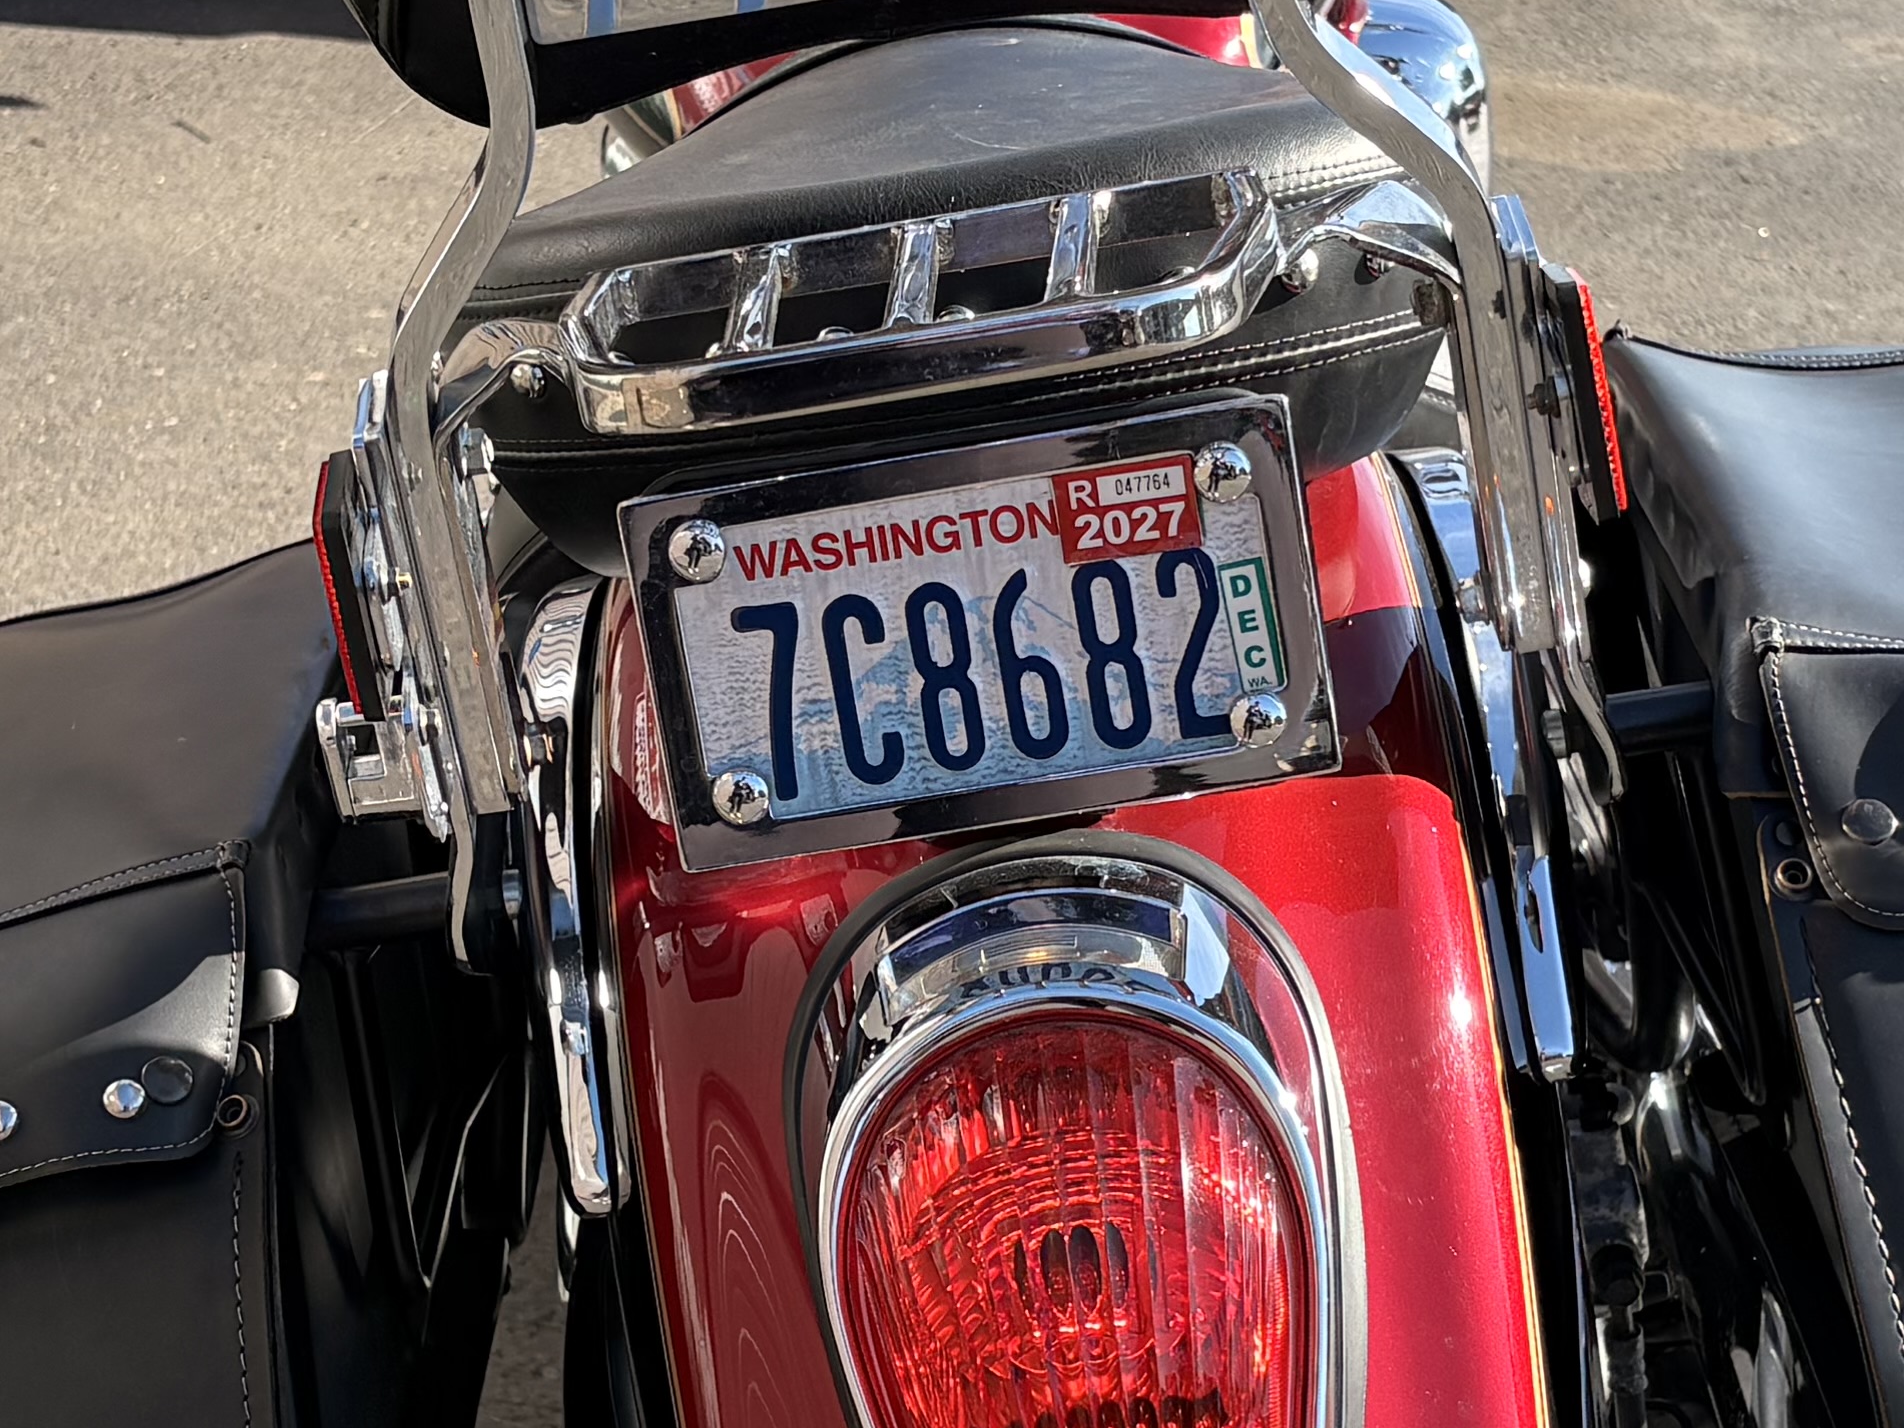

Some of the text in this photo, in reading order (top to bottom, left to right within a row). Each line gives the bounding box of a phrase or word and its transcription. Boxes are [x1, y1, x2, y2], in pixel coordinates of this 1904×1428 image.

[1067, 471, 1171, 511] R 047764
[1074, 500, 1186, 550] 2027
[733, 498, 1060, 582] WASHINGTON
[1229, 574, 1267, 669] DEC
[730, 546, 1233, 802] 7C8682
